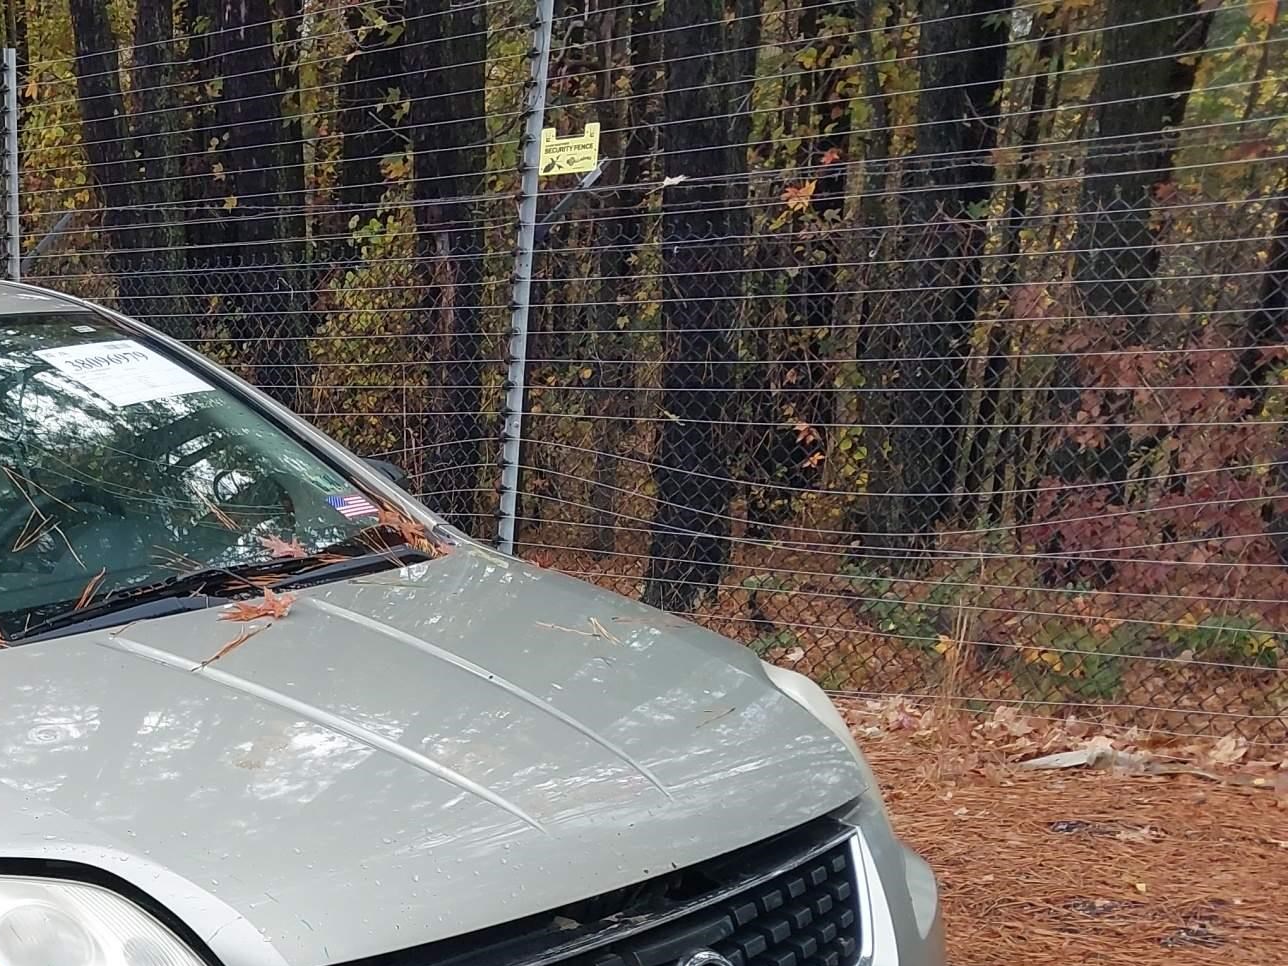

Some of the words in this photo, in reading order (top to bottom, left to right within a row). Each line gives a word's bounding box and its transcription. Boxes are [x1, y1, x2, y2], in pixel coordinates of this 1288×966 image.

[544, 144, 573, 155] SECURITY
[574, 142, 594, 152] FENCE
[64, 350, 149, 373] 38096979
